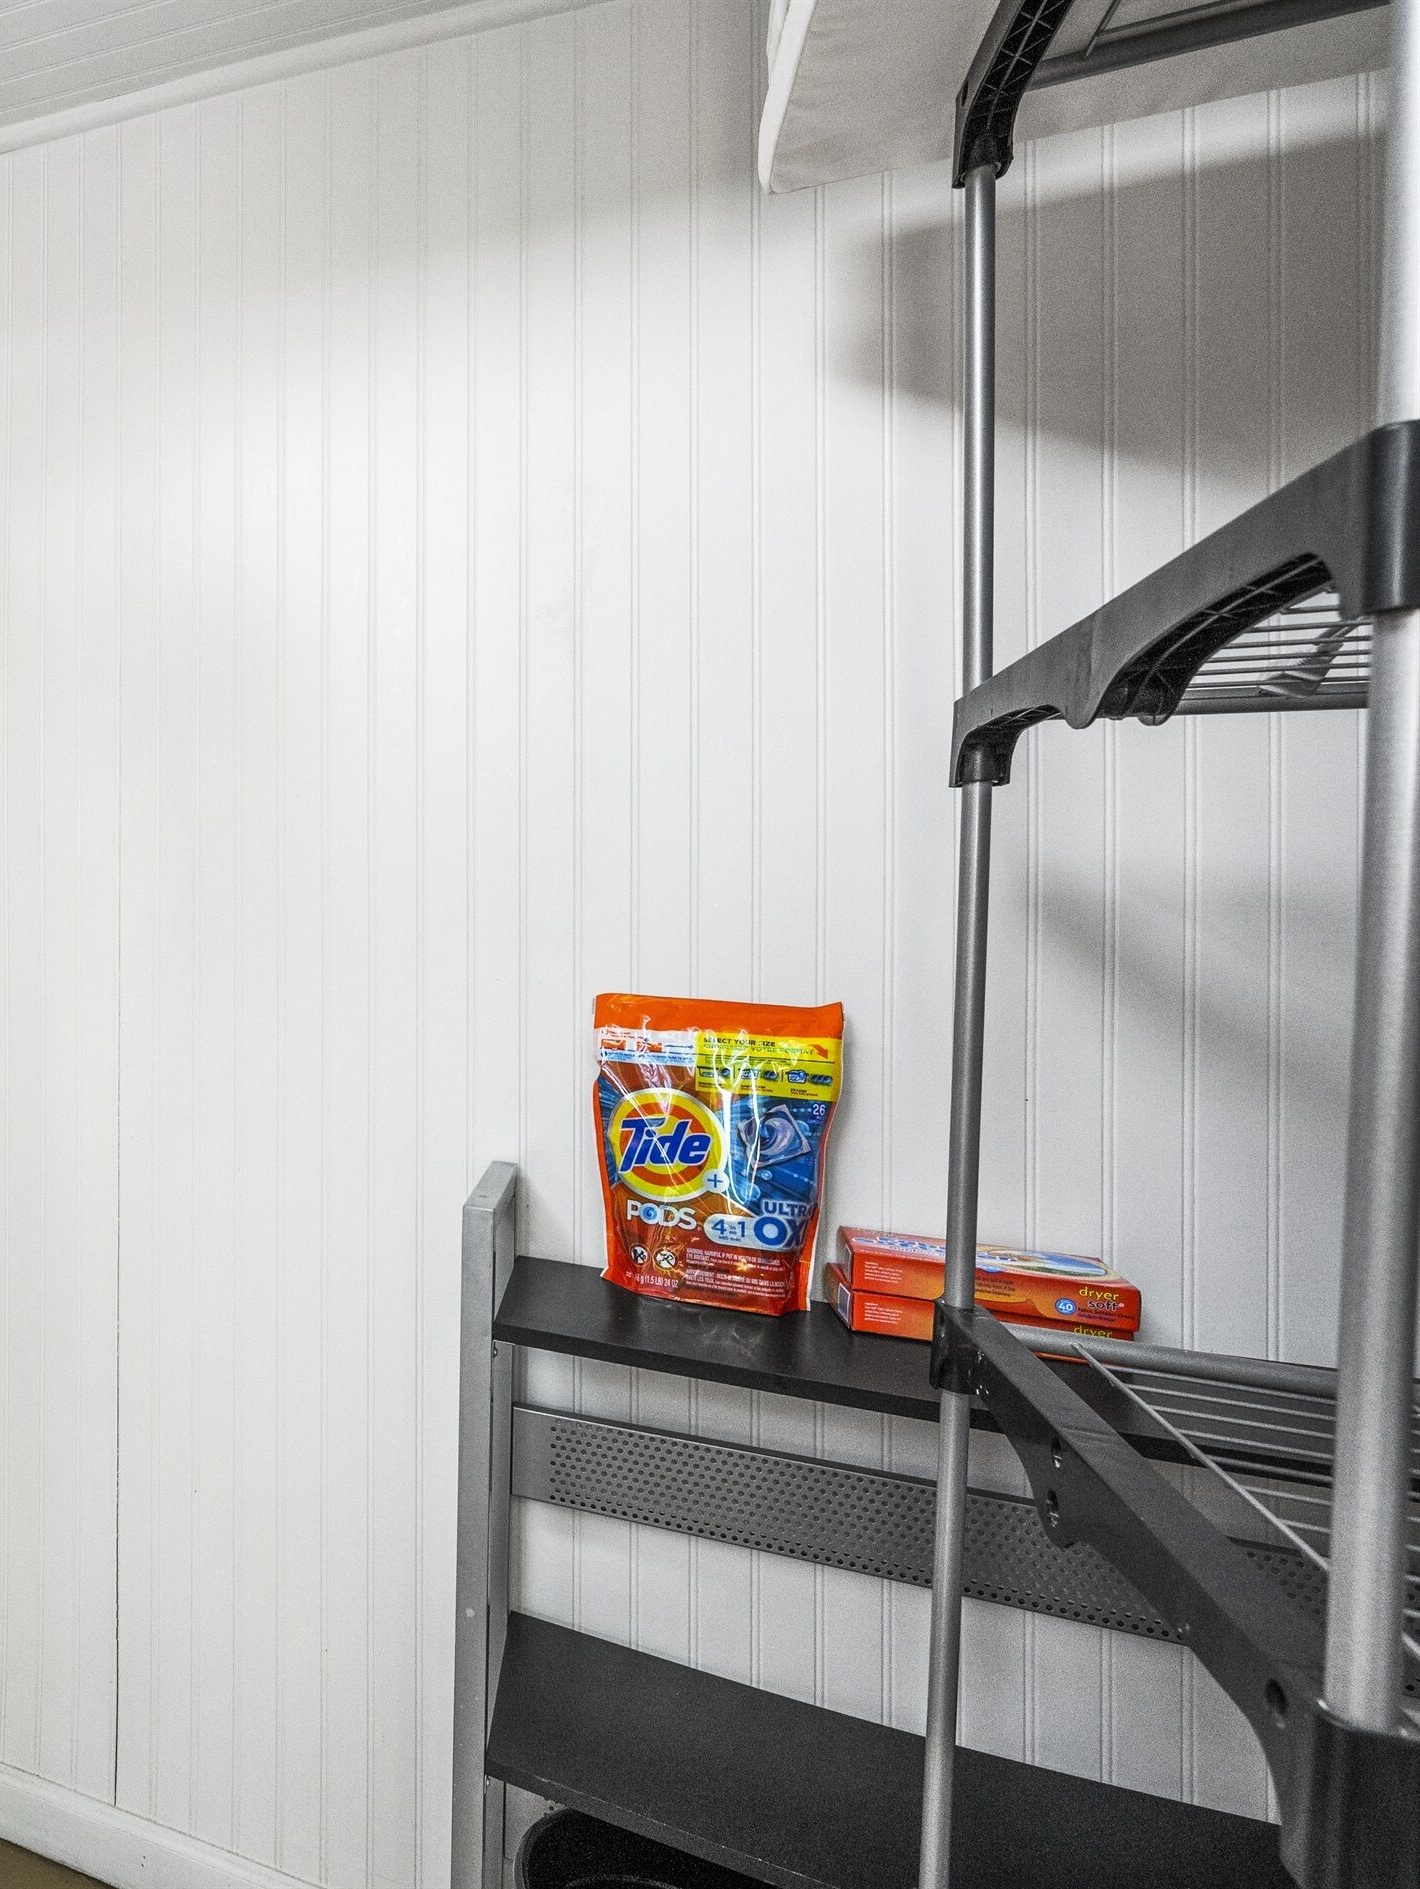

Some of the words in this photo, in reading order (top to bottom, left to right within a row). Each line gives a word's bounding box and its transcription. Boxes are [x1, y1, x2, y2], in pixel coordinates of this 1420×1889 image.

[812, 1103, 826, 1116] 26
[618, 1116, 712, 1175] Tide
[626, 1199, 698, 1232] PODS
[711, 1218, 727, 1236] 4
[737, 1221, 746, 1238] 1
[644, 1273, 655, 1285] (1.5
[655, 1276, 664, 1287] LB)
[664, 1278, 671, 1287] 24
[671, 1279, 680, 1289] OZ
[1078, 1286, 1120, 1301] dryer
[1058, 1302, 1074, 1312] 40
[1073, 1325, 1114, 1339] dryer
